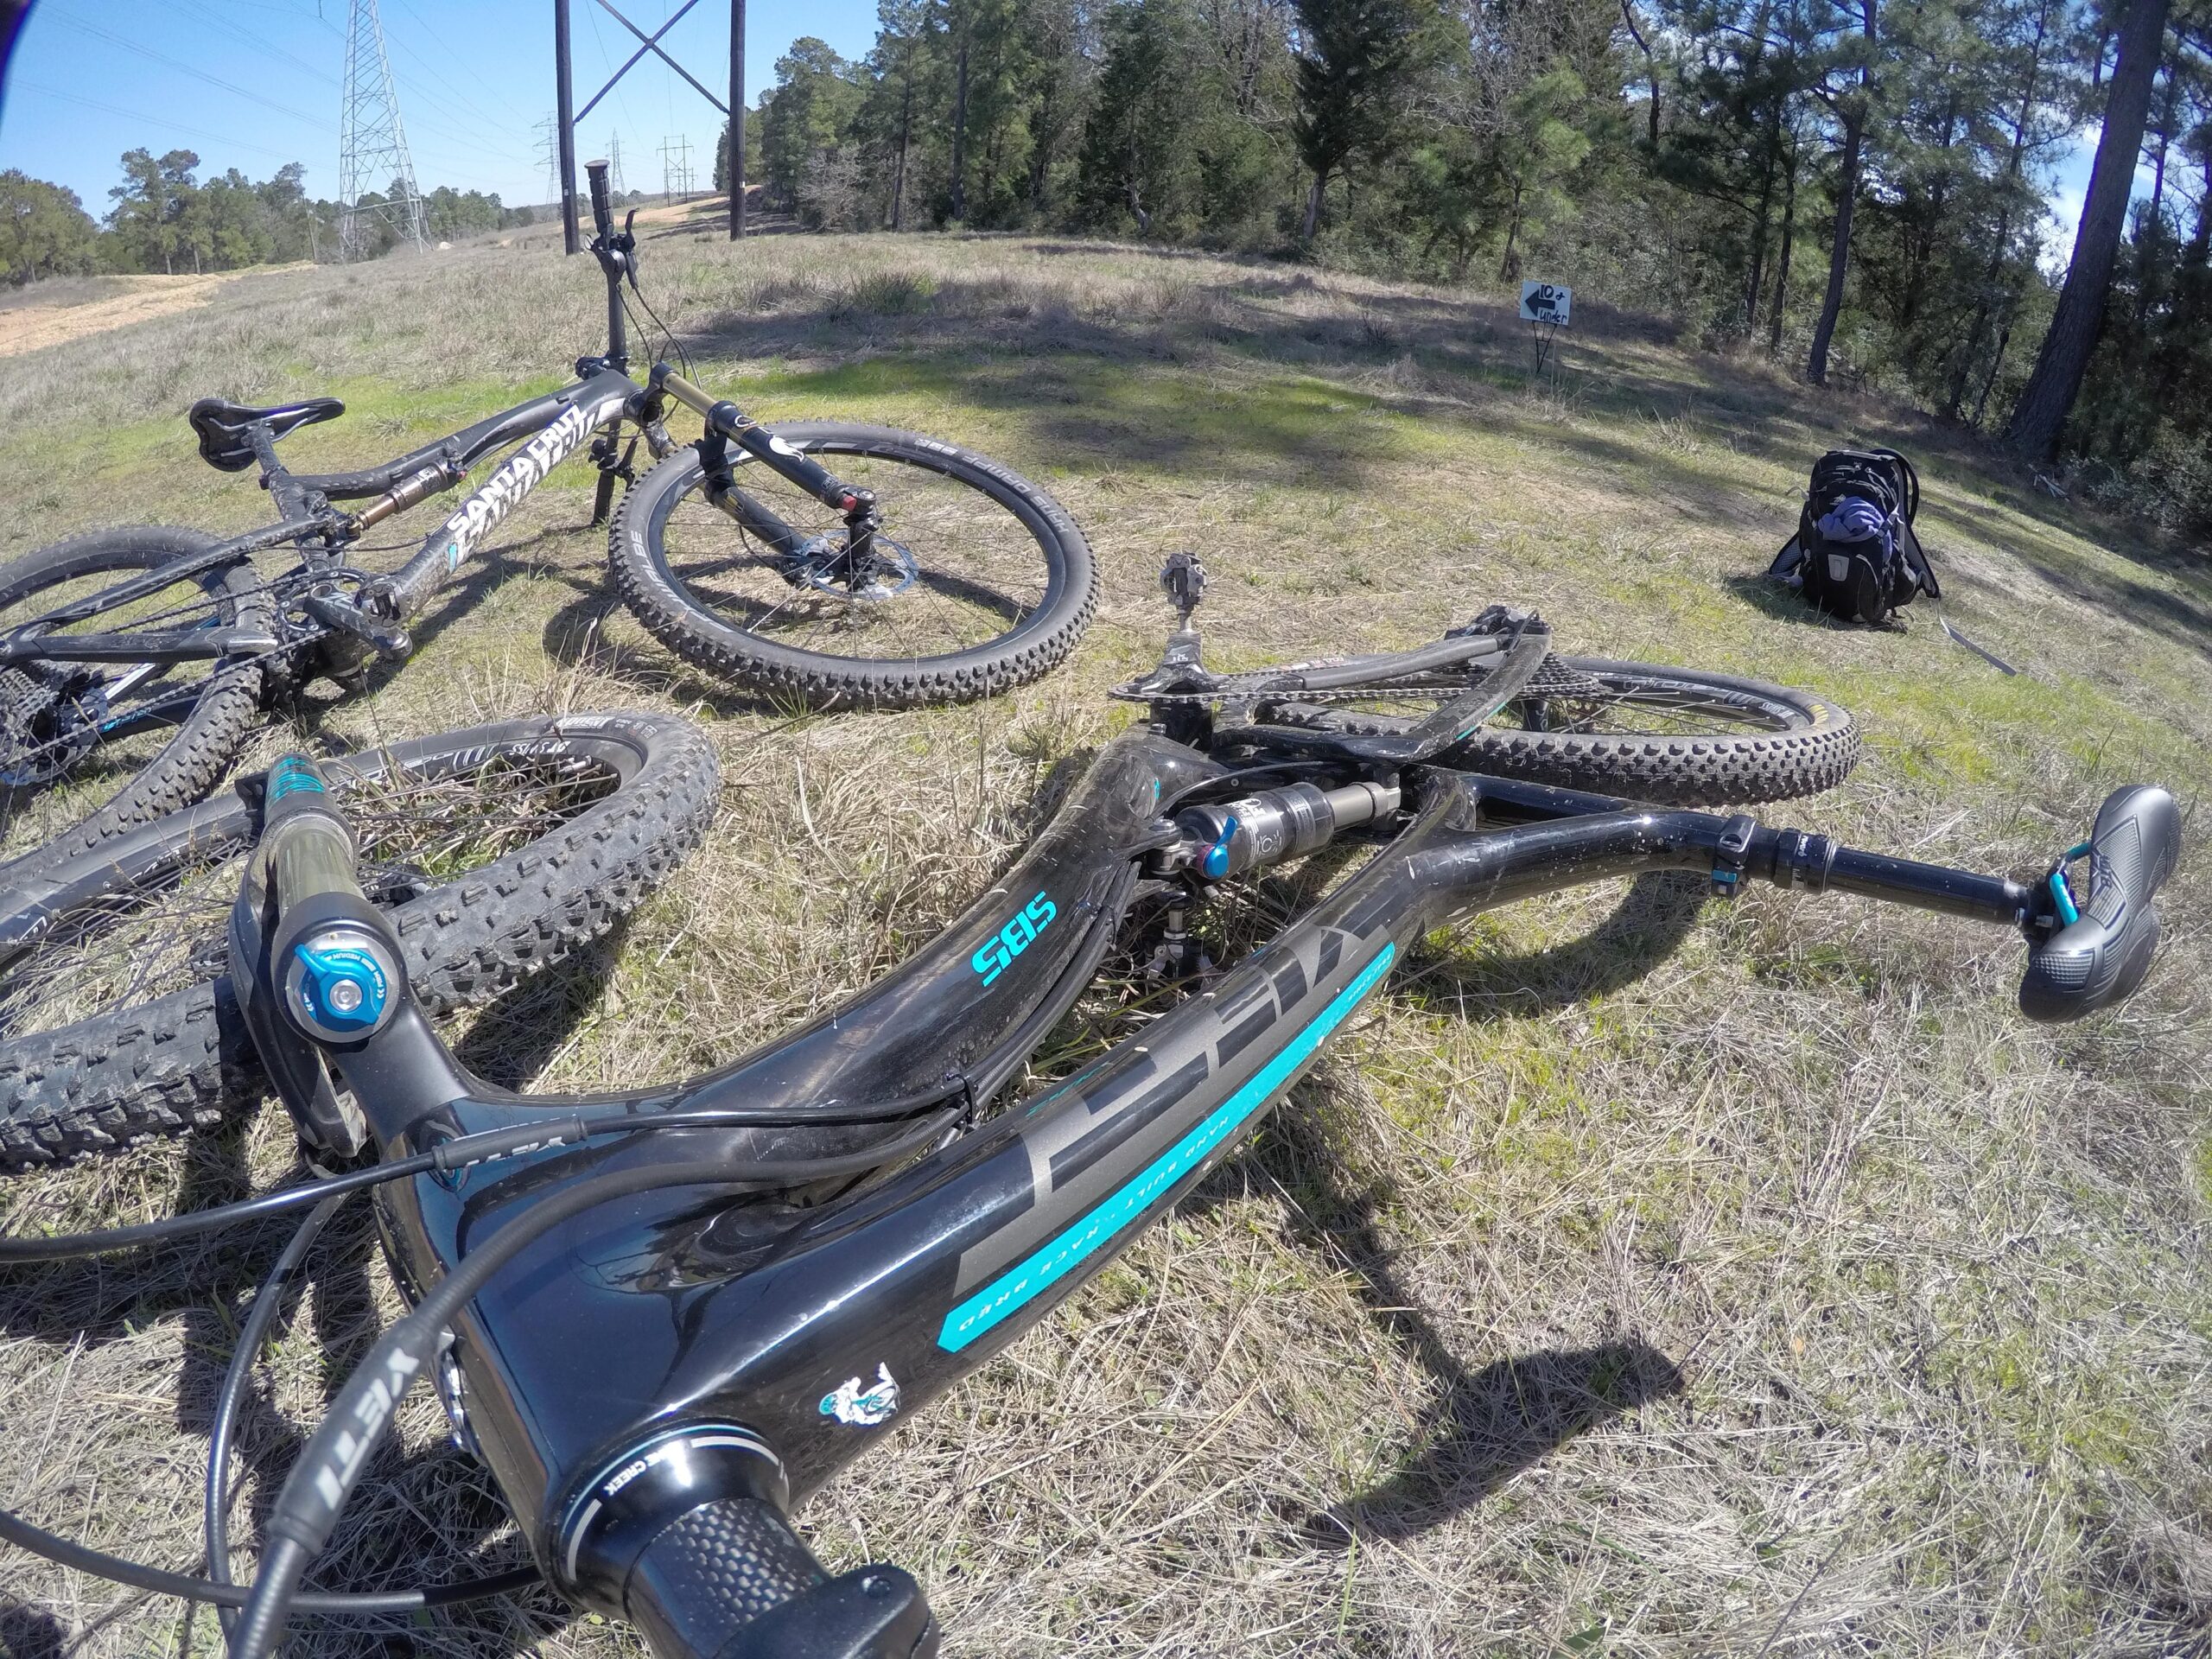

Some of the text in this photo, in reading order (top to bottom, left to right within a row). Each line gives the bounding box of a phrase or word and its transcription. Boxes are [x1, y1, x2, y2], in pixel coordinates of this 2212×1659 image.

[1539, 284, 1554, 299] 10
[1540, 309, 1567, 323] under
[447, 404, 588, 541] SANTA CRUZ
[962, 455, 1070, 533] HANS DAMPF
[333, 952, 361, 961] MEDIUM
[972, 891, 1057, 987] SB5
[373, 970, 384, 988] FIRM
[957, 1116, 1229, 1332] HAND BUILT RACE BRED
[315, 1347, 420, 1510] YETI
[603, 1460, 646, 1497] CREEK
